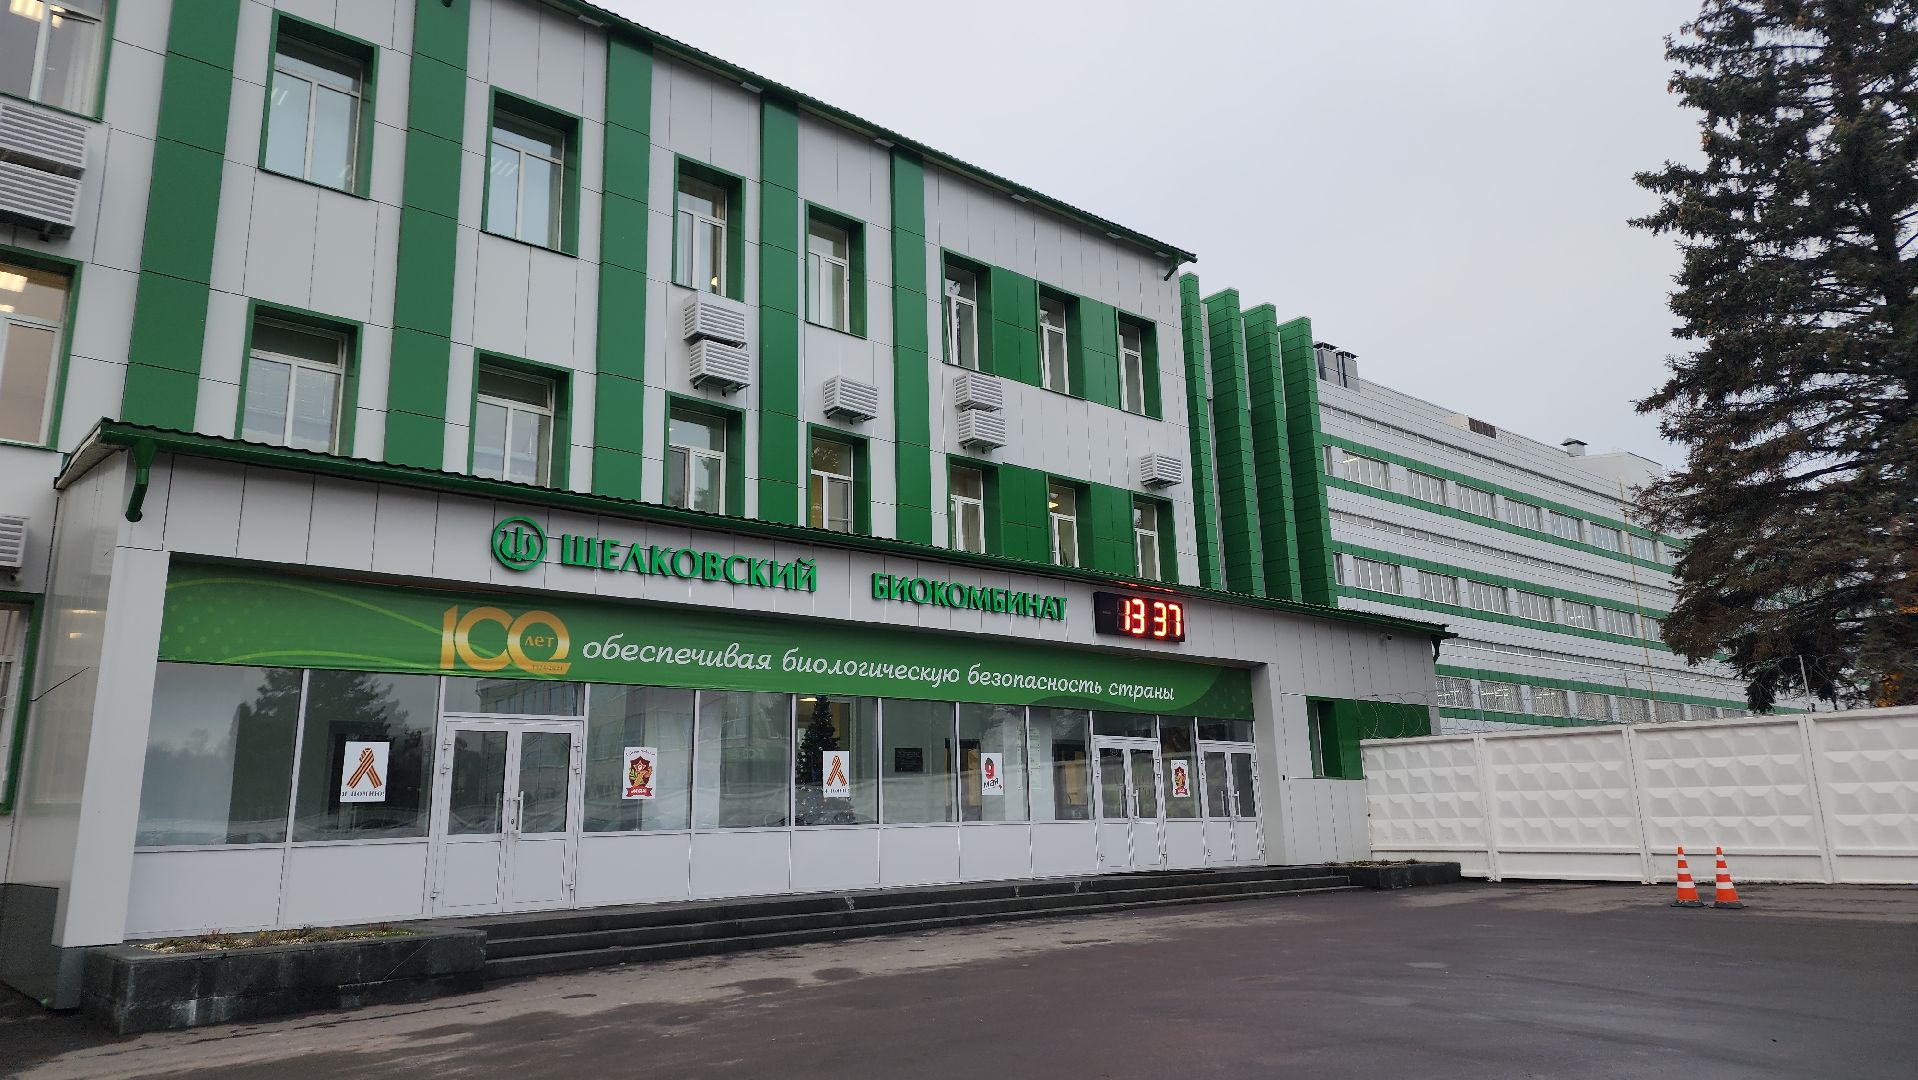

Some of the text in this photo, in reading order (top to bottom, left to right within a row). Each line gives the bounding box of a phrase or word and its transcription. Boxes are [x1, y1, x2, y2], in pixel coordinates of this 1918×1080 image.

[561, 533, 1068, 622] ЩЕЛКОВСКИЙ БИОКОМБИНАТ
[524, 634, 555, 648] лет
[582, 632, 1175, 703] обеспечивая биологическую безопасность страны
[984, 758, 994, 779] 9
